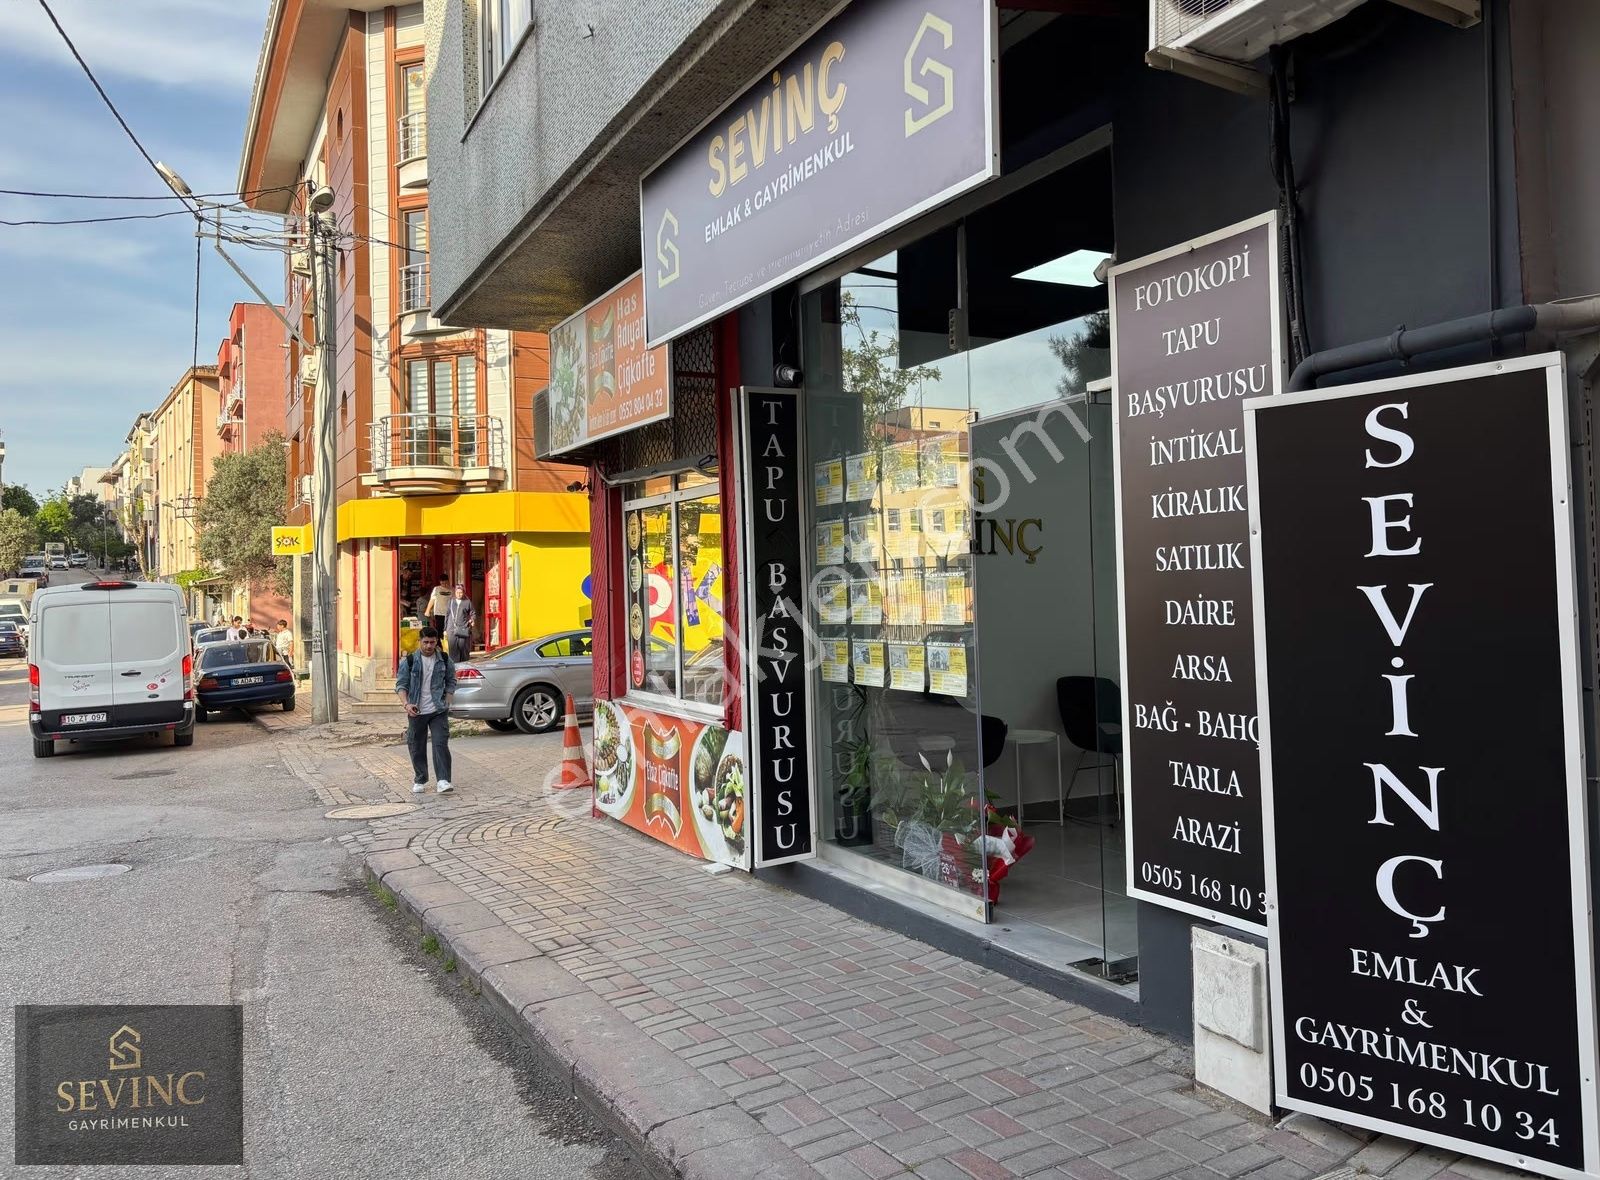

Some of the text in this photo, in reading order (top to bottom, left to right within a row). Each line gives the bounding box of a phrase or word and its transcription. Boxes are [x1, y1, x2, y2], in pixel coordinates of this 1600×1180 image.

[708, 42, 847, 198] SEVİNÇ
[705, 132, 854, 243] EMLAK & GAYRİMENKUL
[835, 210, 869, 236] Adresi
[1134, 244, 1251, 312] FOTOKOPİ
[617, 293, 637, 320] Has
[1163, 318, 1220, 356] TAPU
[617, 351, 655, 397] Çiğköfte
[1128, 364, 1267, 418] BAŞVURUSU
[1150, 428, 1244, 466] İNTİKAL
[1151, 485, 1246, 519] KİRALIK
[1155, 542, 1245, 571] SATILIK
[763, 400, 797, 849] TAPU BAŞVURUSU
[1165, 593, 1236, 626] DAİRE
[1172, 654, 1232, 683] ARSA
[1356, 402, 1446, 939] SEVİNÇ
[92, 713, 105, 721] 097
[1135, 700, 1178, 732] BAĞ
[1197, 710, 1259, 750] BAHÇ
[1169, 760, 1243, 798] TARLA
[1172, 815, 1241, 854] ARAZİ
[1142, 861, 1267, 914] 0505 168 10 3
[1350, 948, 1484, 996] EMLAK
[1401, 999, 1434, 1028] &
[1295, 1016, 1560, 1096] GAYRİMENKUL
[1300, 1062, 1560, 1147] 0505 168 10 34
